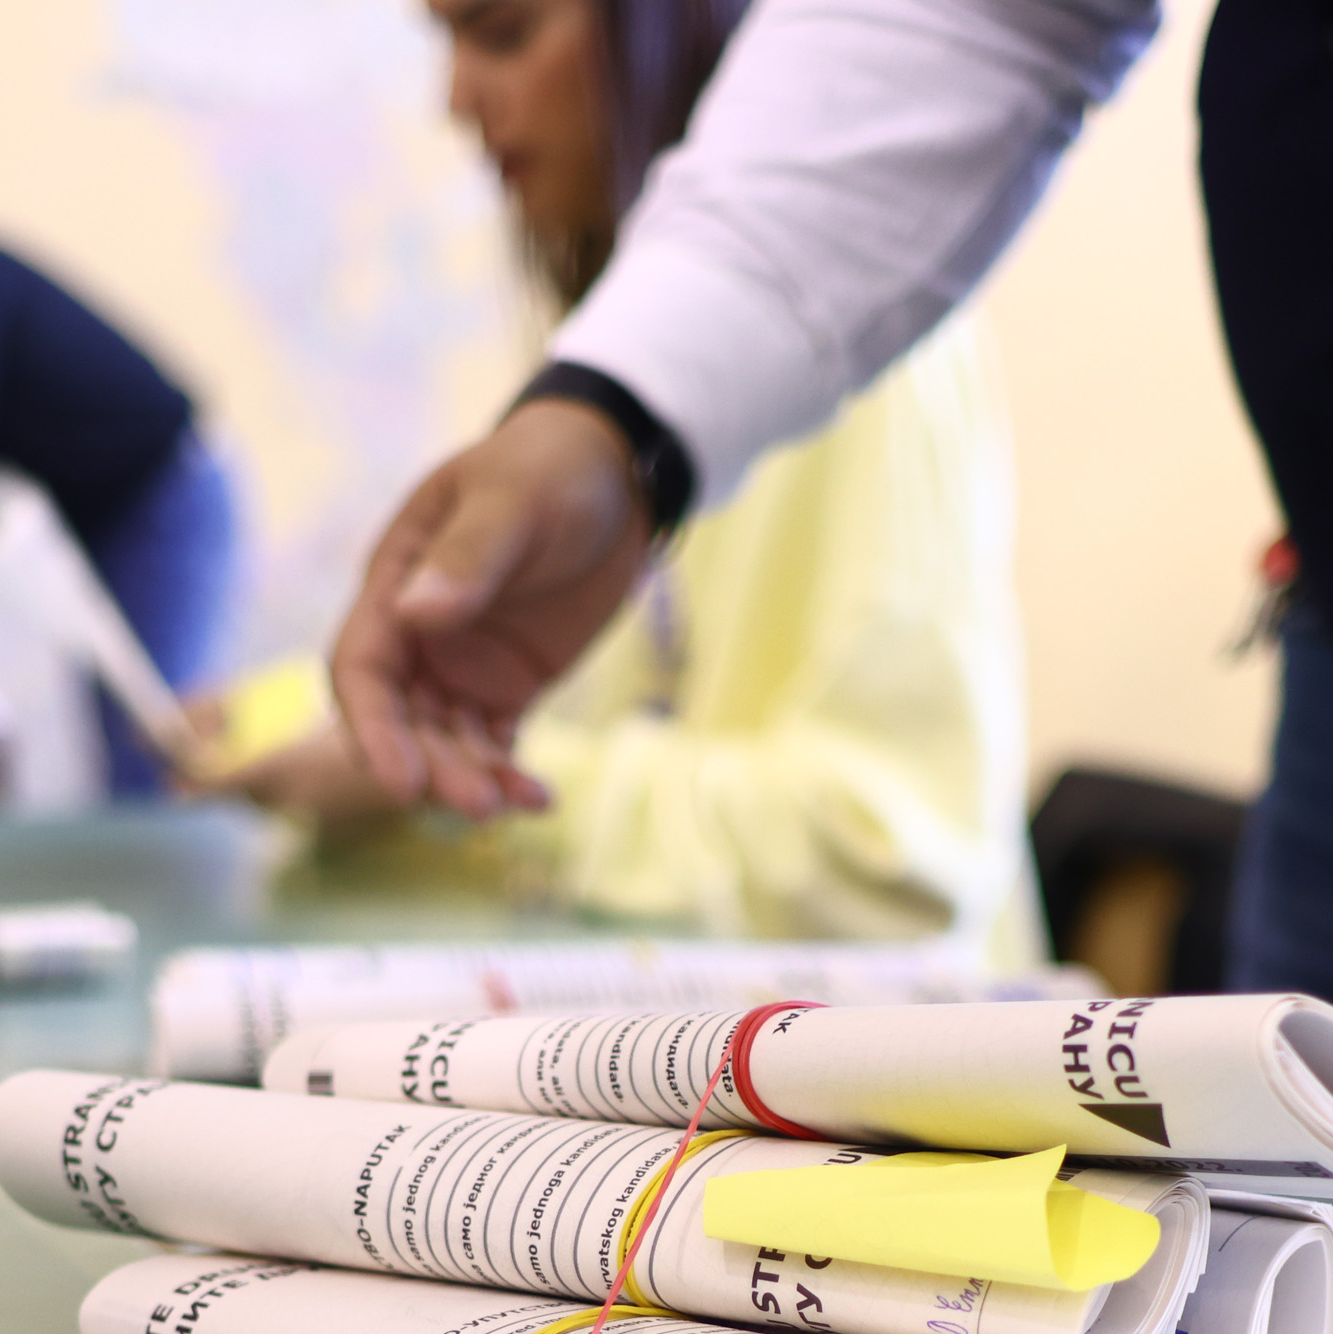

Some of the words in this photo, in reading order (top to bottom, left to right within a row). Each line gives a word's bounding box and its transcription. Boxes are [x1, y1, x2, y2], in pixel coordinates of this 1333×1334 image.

[402, 1154, 436, 1215] jednog
[463, 1156, 498, 1212] једног
[616, 1142, 678, 1204] kandidata,
[526, 1169, 565, 1240] jednoga
[461, 1215, 475, 1261] само
[528, 1243, 550, 1286] samo
